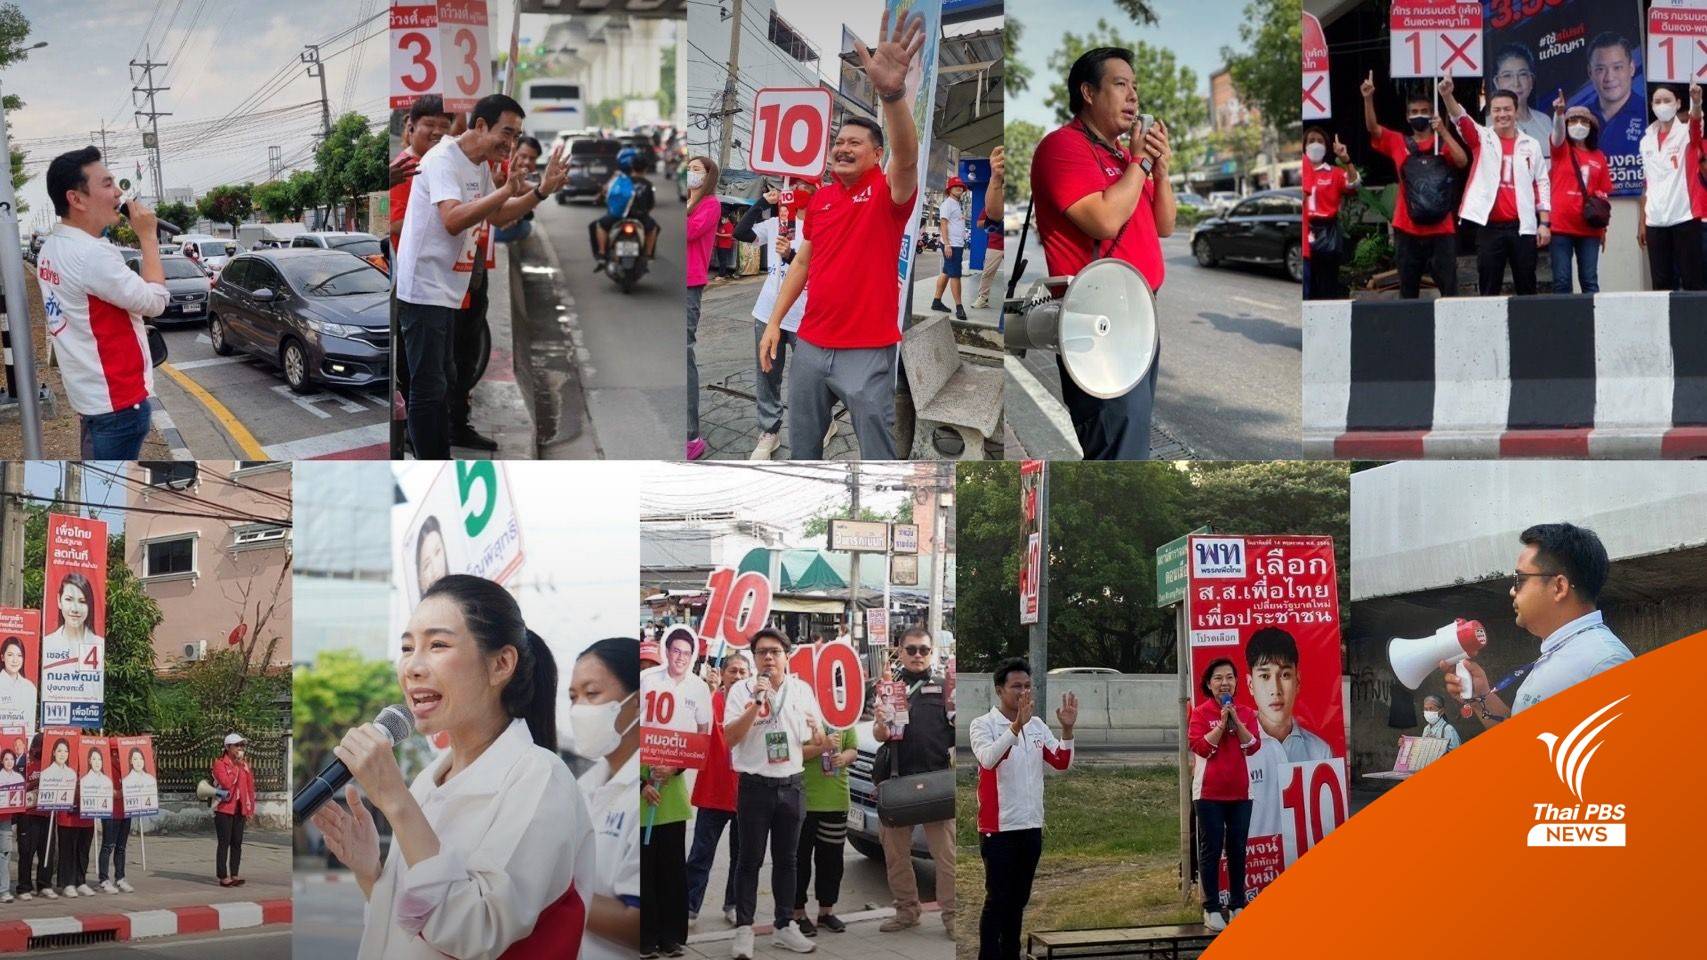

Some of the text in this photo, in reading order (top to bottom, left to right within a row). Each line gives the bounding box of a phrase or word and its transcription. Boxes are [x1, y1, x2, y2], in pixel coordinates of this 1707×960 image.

[398, 32, 437, 91] 3
[454, 28, 481, 95] 3
[760, 104, 823, 167] 10
[782, 192, 793, 201] 10
[456, 461, 497, 538] 5
[55, 522, 91, 539] เพื่อไทย
[1195, 543, 1240, 565] พท
[1256, 548, 1327, 575] เลือก
[1199, 576, 1329, 601] ส.ส.เพื่อไทย
[702, 568, 771, 646] 10
[1199, 603, 1332, 627] เพื่อประชาชน
[1253, 599, 1331, 612] เปลี่ยนรัฐบาลใหม่
[1196, 634, 1236, 643] โปรดเลือก
[83, 646, 98, 670] 4
[47, 669, 100, 682] กมลพัฒน์
[790, 644, 862, 727] 10
[645, 690, 675, 724] 10
[61, 791, 68, 800] 4
[101, 799, 108, 808] 4
[145, 797, 151, 806] 4
[1282, 763, 1345, 859] 10
